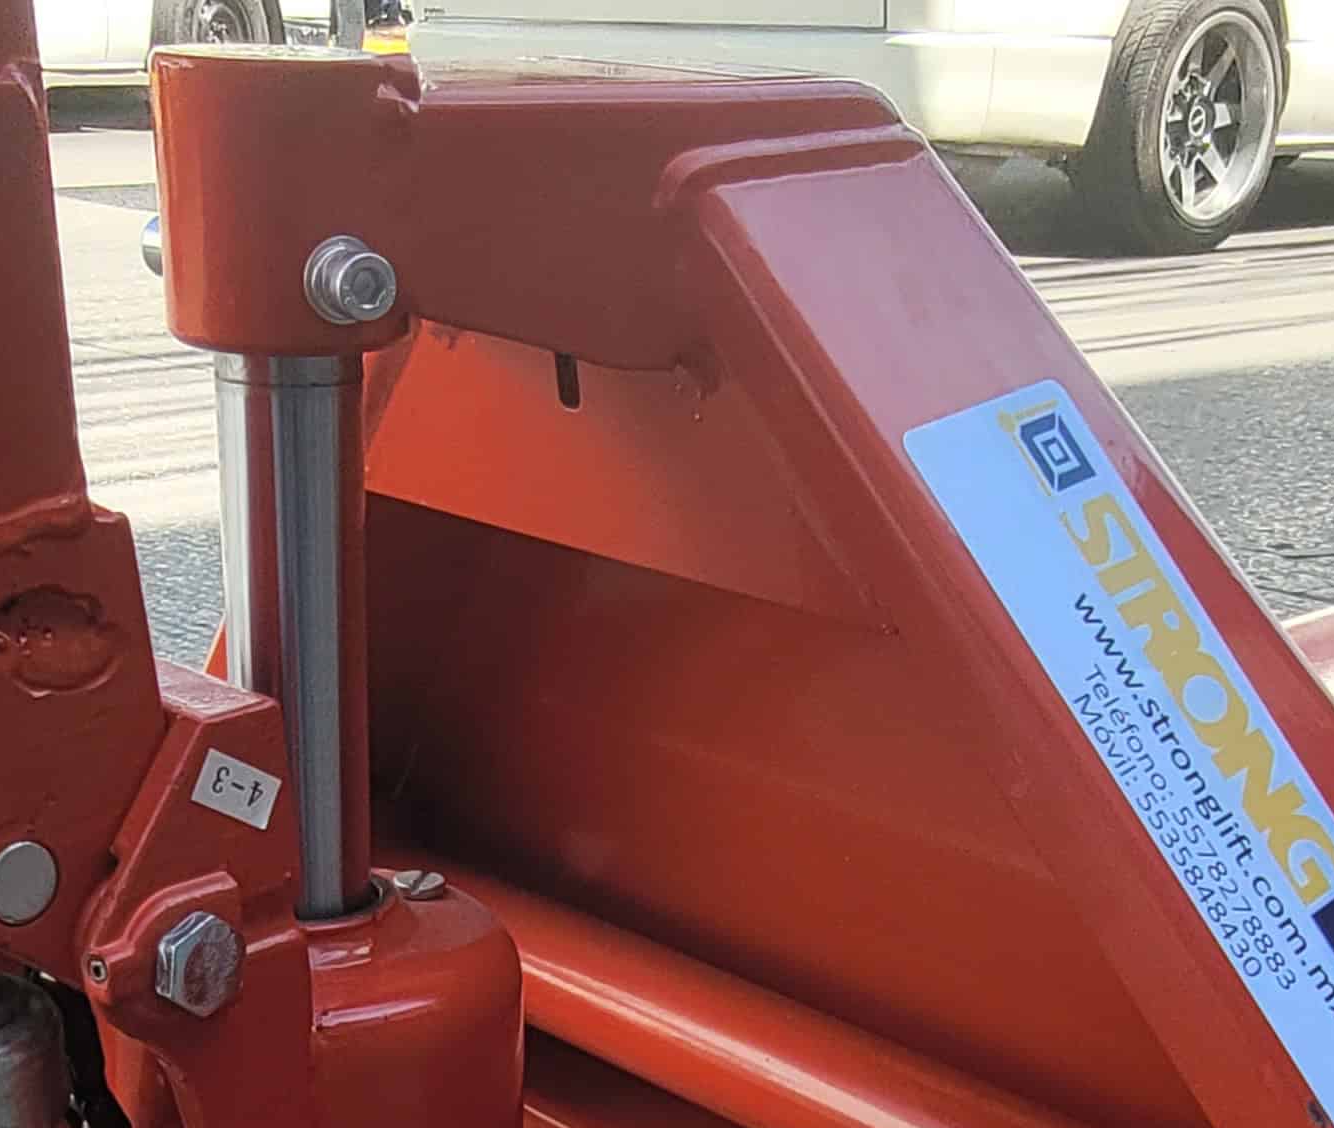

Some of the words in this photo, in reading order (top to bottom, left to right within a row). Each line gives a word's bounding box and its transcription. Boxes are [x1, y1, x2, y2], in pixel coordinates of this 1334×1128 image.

[211, 766, 264, 807] 4-3
[1073, 693, 1141, 787] Móvil:
[1136, 791, 1263, 978] 5535848430
[1085, 663, 1174, 802] Teléfono:
[1171, 806, 1297, 990] 5578278883
